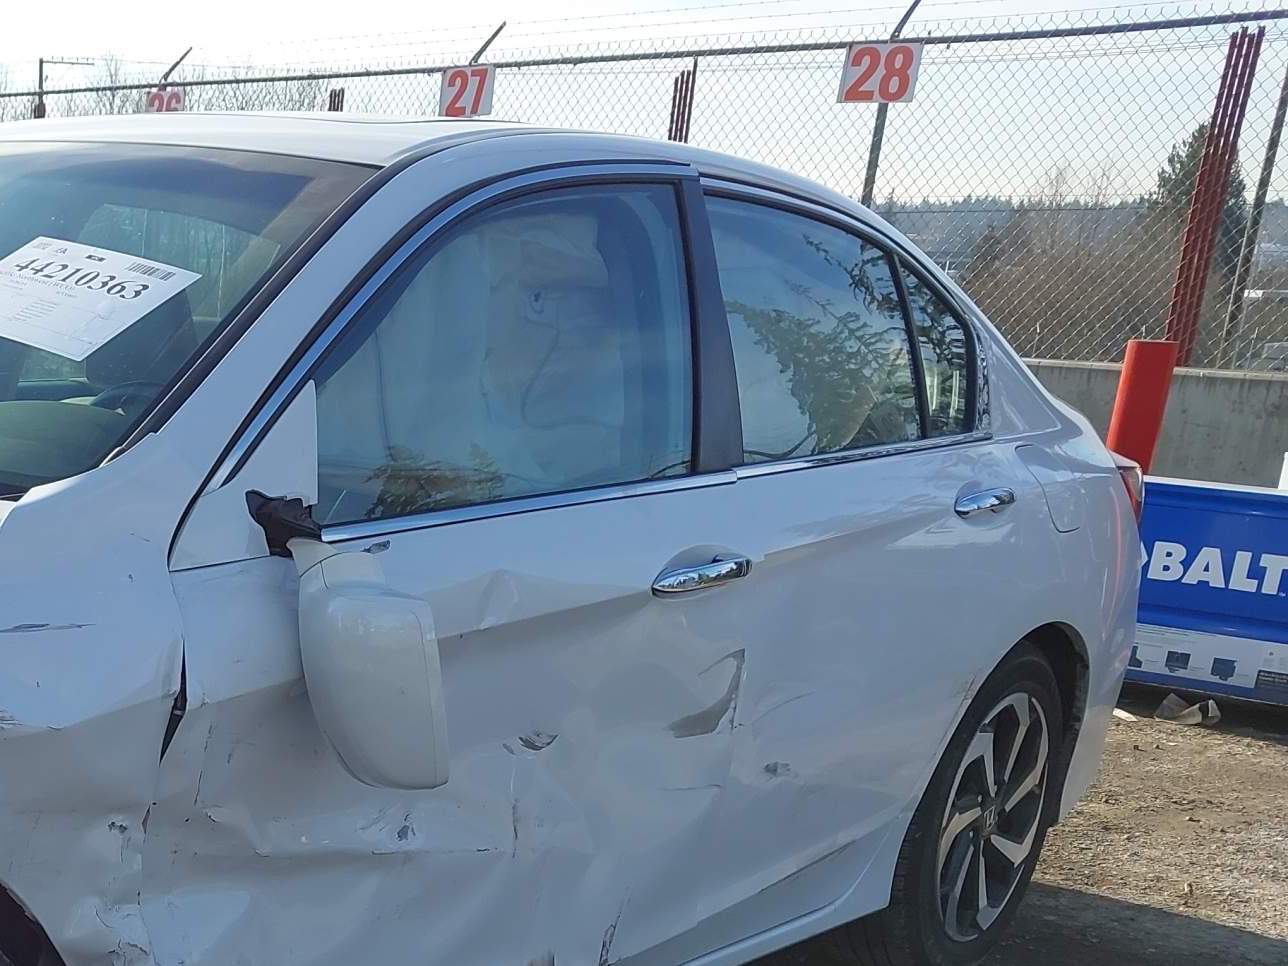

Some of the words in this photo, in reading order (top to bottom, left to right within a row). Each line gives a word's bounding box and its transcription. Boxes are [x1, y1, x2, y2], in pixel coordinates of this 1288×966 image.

[445, 66, 489, 116] 27
[844, 45, 915, 102] 28
[14, 257, 150, 300] 44210363
[1141, 540, 1288, 595] BALT
